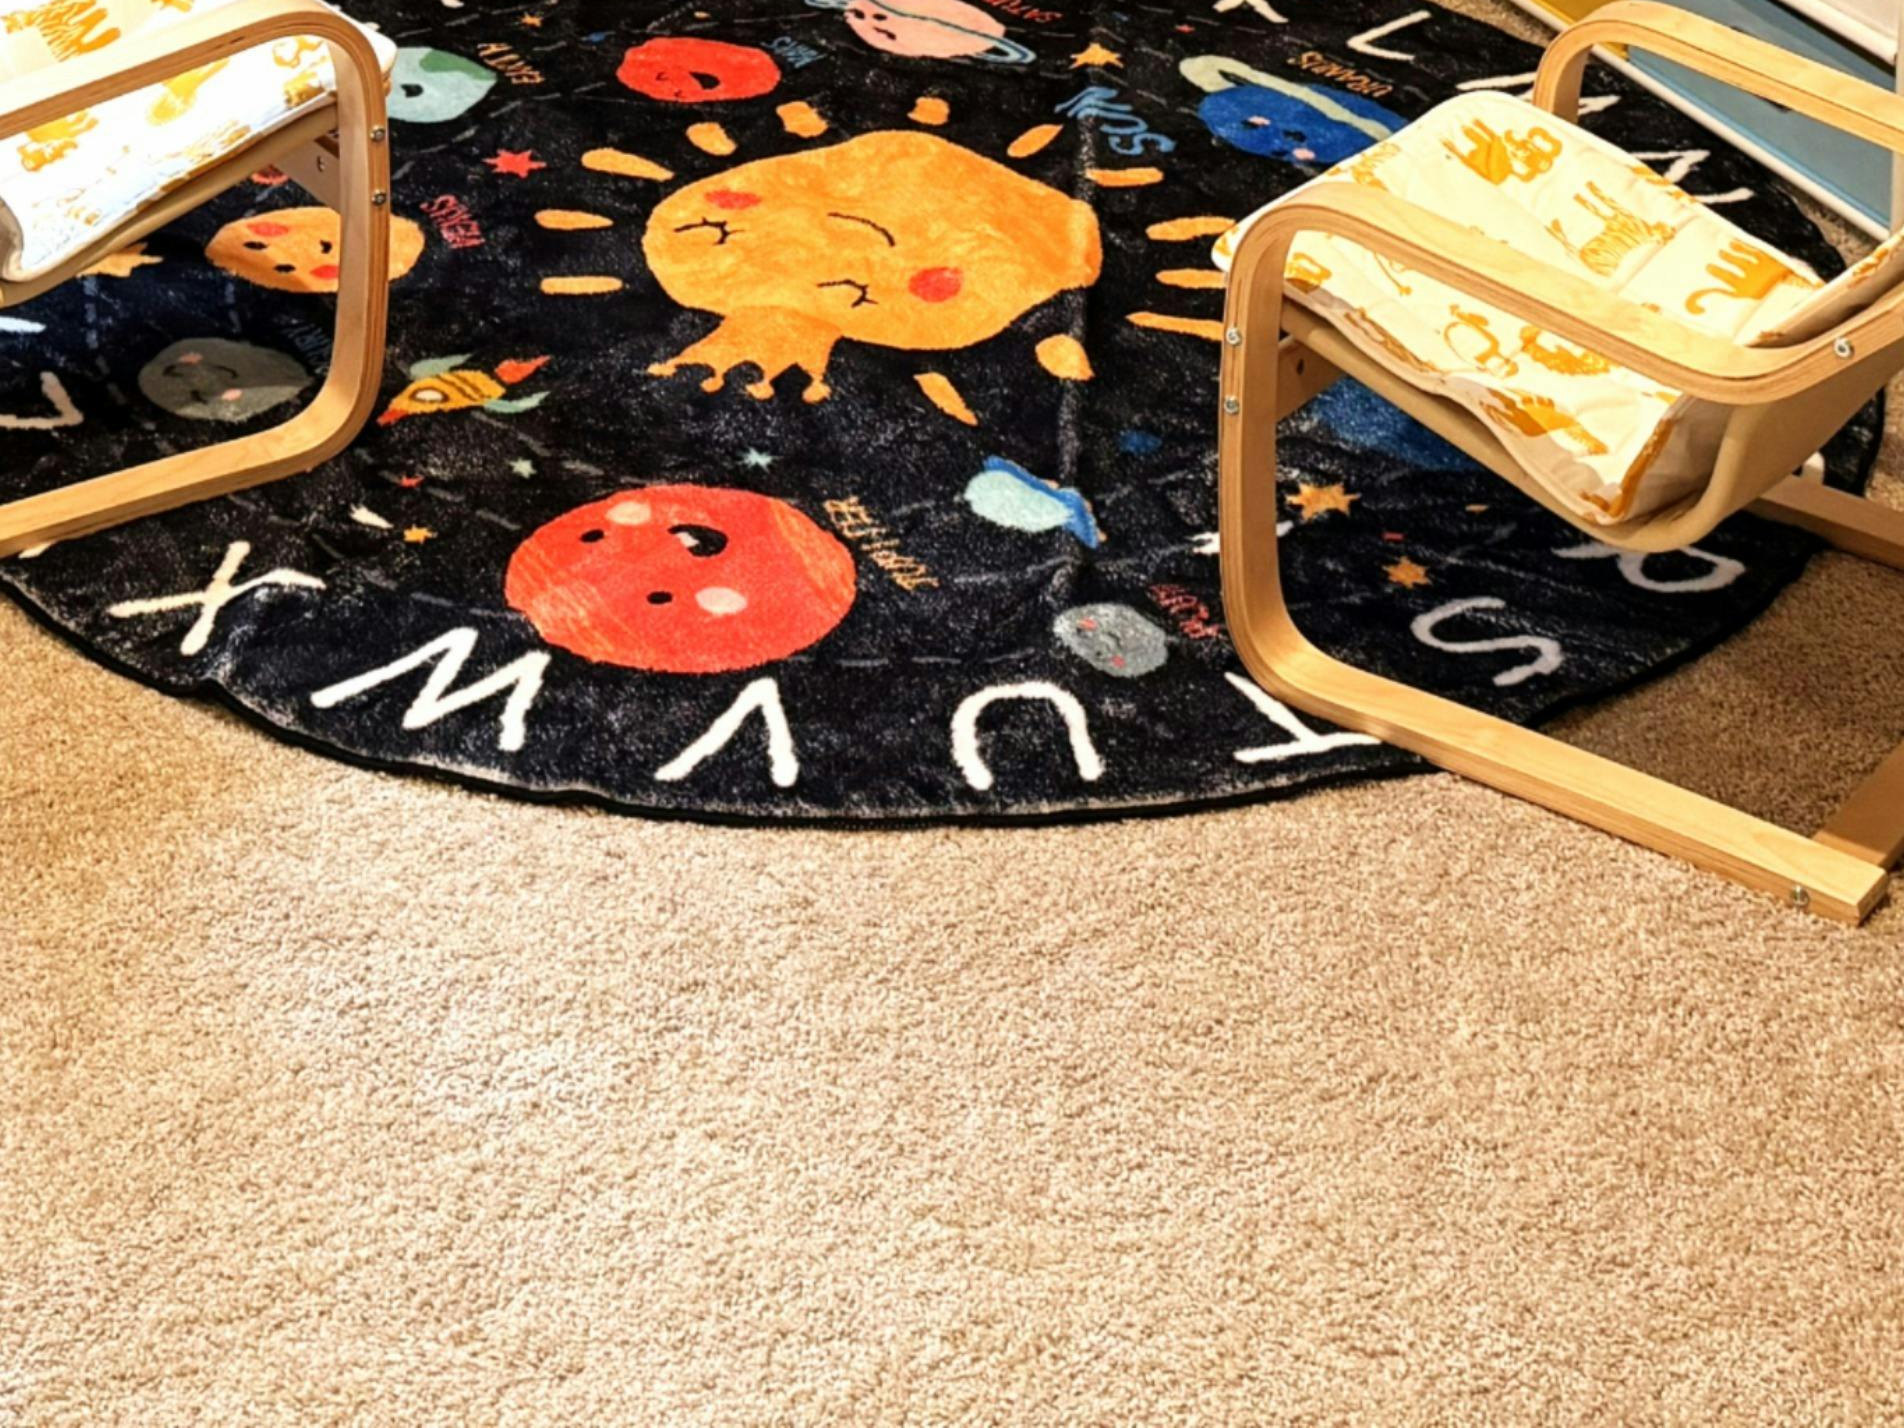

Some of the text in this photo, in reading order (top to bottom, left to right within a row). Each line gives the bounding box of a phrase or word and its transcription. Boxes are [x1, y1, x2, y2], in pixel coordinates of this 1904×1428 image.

[1287, 50, 1395, 99] URANUS
[1347, 11, 1431, 61] L
[1053, 87, 1176, 157] SUN
[419, 194, 486, 250] VENUS
[106, 540, 326, 656] X
[1410, 596, 1565, 687] S
[655, 677, 800, 787] V
[951, 681, 1106, 791] U
